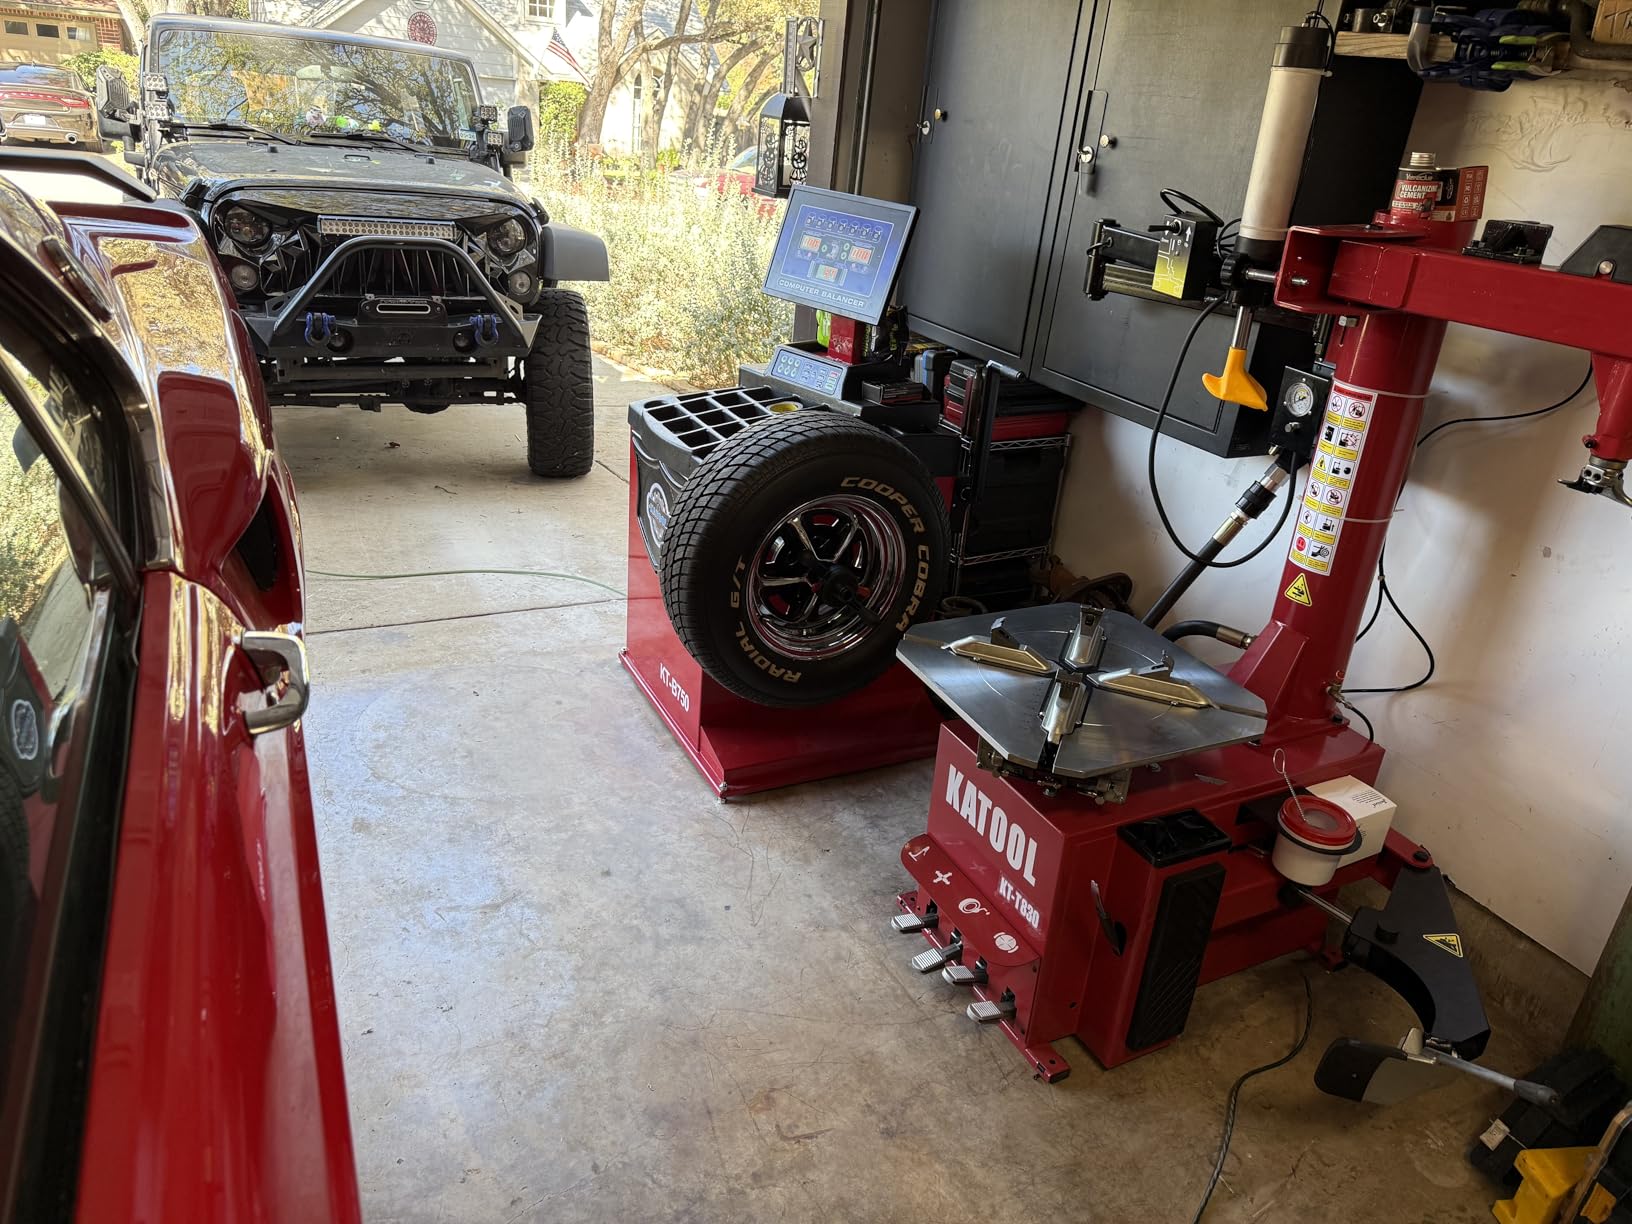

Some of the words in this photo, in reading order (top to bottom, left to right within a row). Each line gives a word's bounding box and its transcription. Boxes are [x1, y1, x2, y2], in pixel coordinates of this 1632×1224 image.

[1399, 191, 1426, 199] CEMENT
[779, 280, 819, 296] COMPUTER
[821, 291, 864, 307] BALANCER
[841, 477, 926, 534] COOPER
[896, 544, 930, 632] COBRA
[736, 620, 802, 683] RADIAL
[660, 662, 690, 712] KT-B750
[945, 763, 1038, 888] KATOOL
[999, 876, 1040, 930] KT-T830
